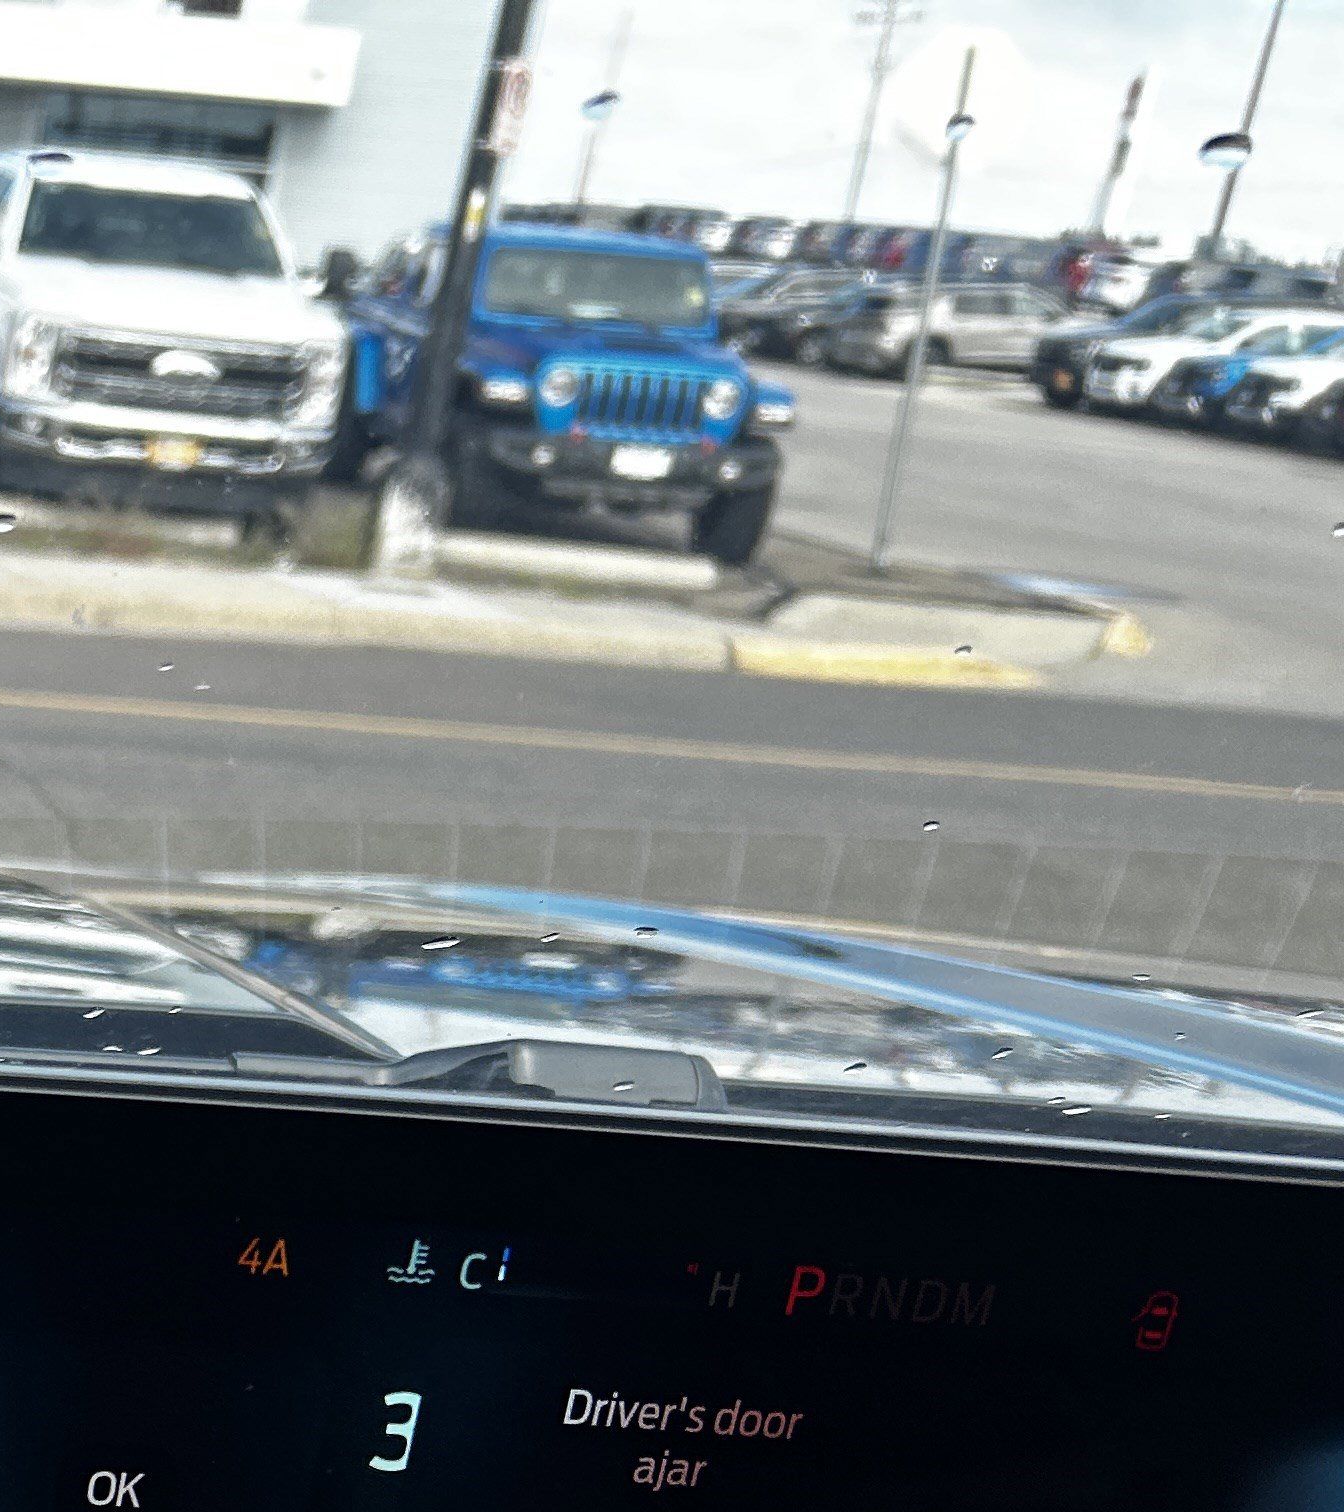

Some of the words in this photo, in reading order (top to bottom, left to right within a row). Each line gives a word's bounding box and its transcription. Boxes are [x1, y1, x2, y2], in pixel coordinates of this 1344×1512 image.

[237, 1236, 290, 1279] 4A
[459, 1252, 488, 1291] C
[708, 1270, 742, 1310] H
[562, 1387, 707, 1434] Driver's
[713, 1398, 804, 1440] door
[86, 1470, 146, 1509] OK
[632, 1449, 708, 1492] ajar
